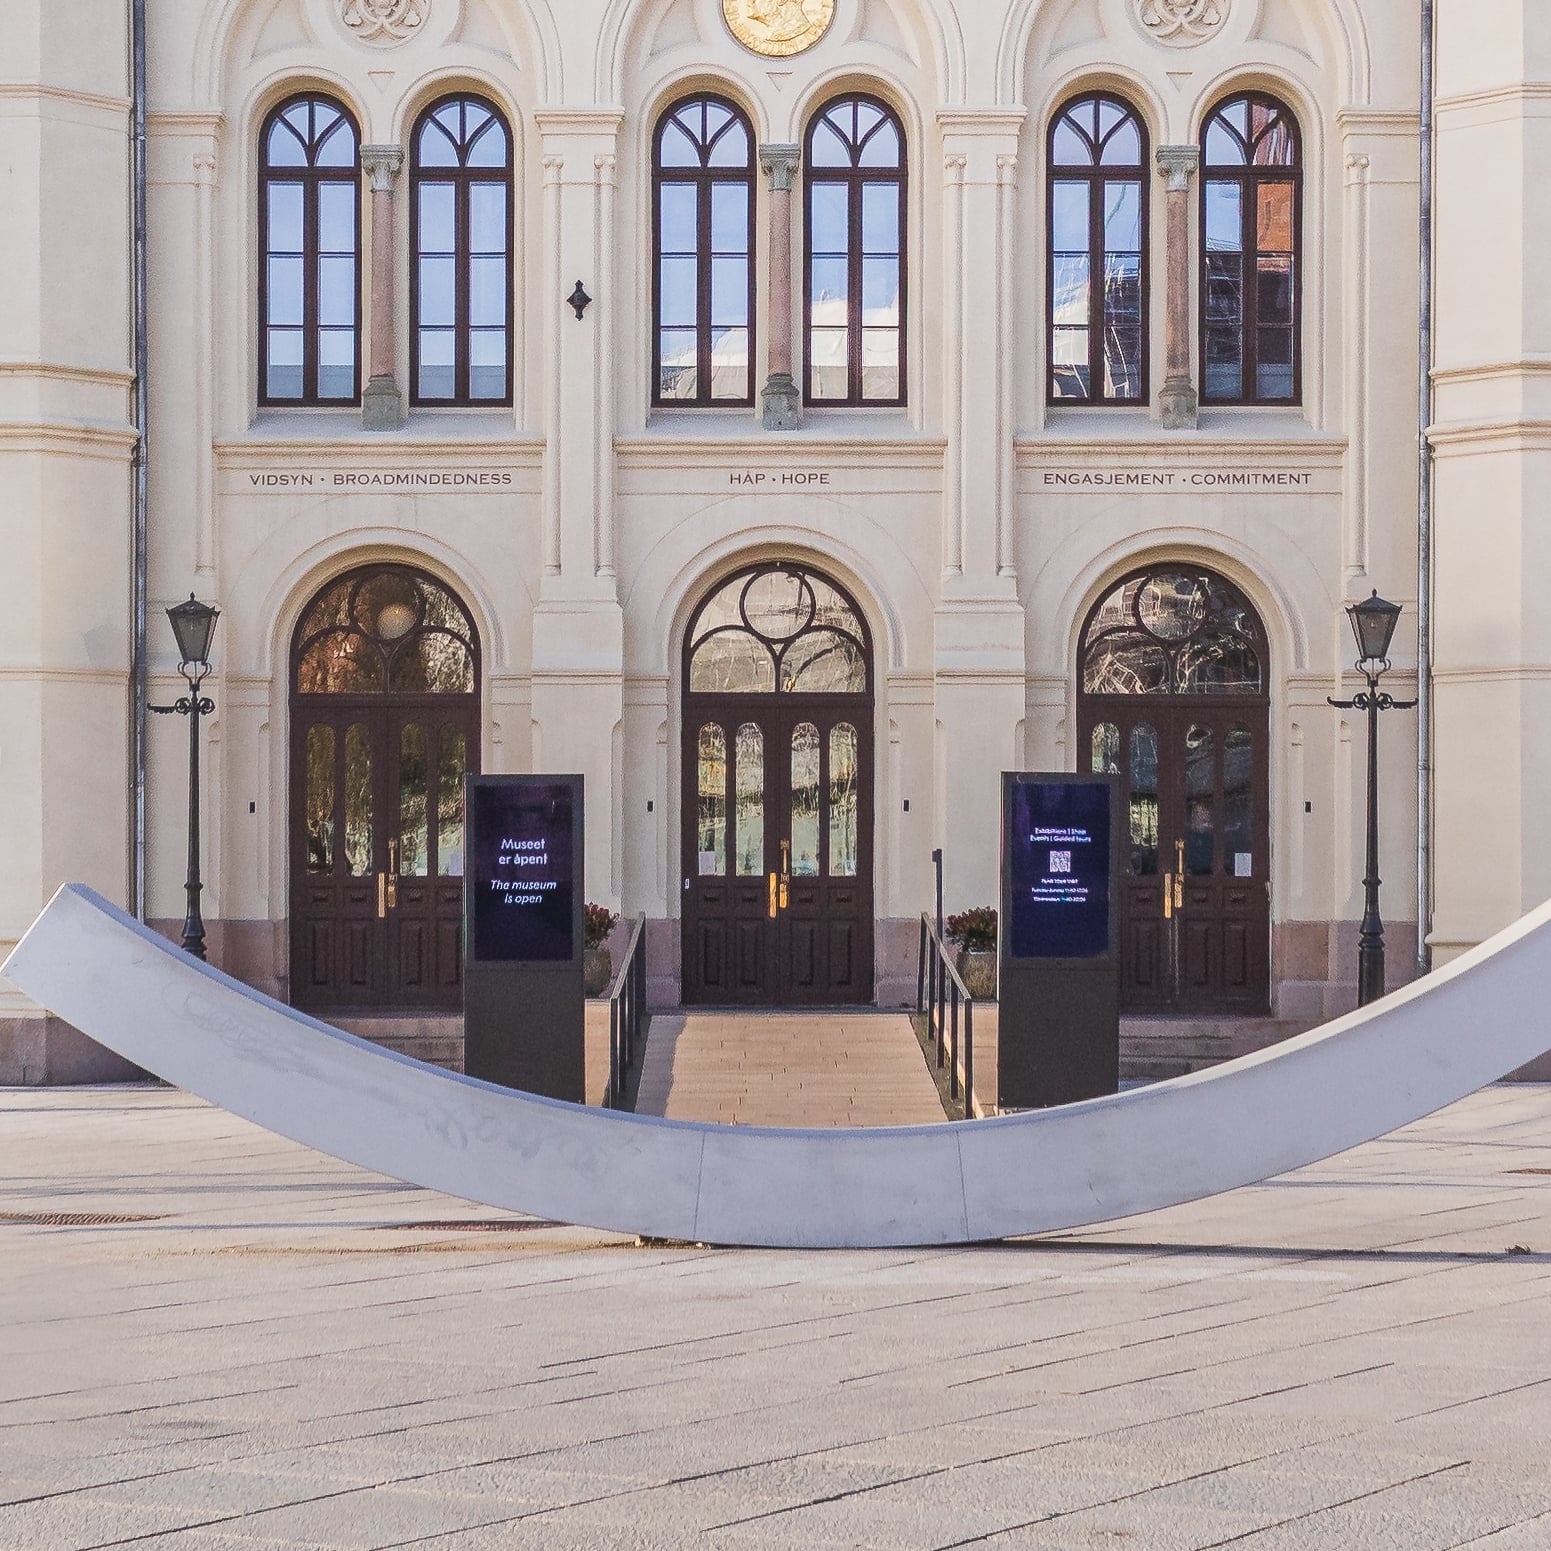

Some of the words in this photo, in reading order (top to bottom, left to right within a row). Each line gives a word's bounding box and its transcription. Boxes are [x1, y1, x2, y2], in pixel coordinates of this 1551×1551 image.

[249, 474, 313, 486] VIDSYN
[333, 473, 512, 486] BROADMINDEDNESS
[729, 470, 766, 485] HÅP
[781, 473, 830, 485] HOPE
[1043, 473, 1175, 485] ENGASJEMENT
[1190, 473, 1312, 486] COMMITMENT
[500, 838, 546, 849] Museet
[498, 855, 513, 865] er
[514, 853, 549, 867] åpent
[490, 879, 510, 890] The
[511, 881, 557, 890] museum
[514, 894, 543, 905] open
